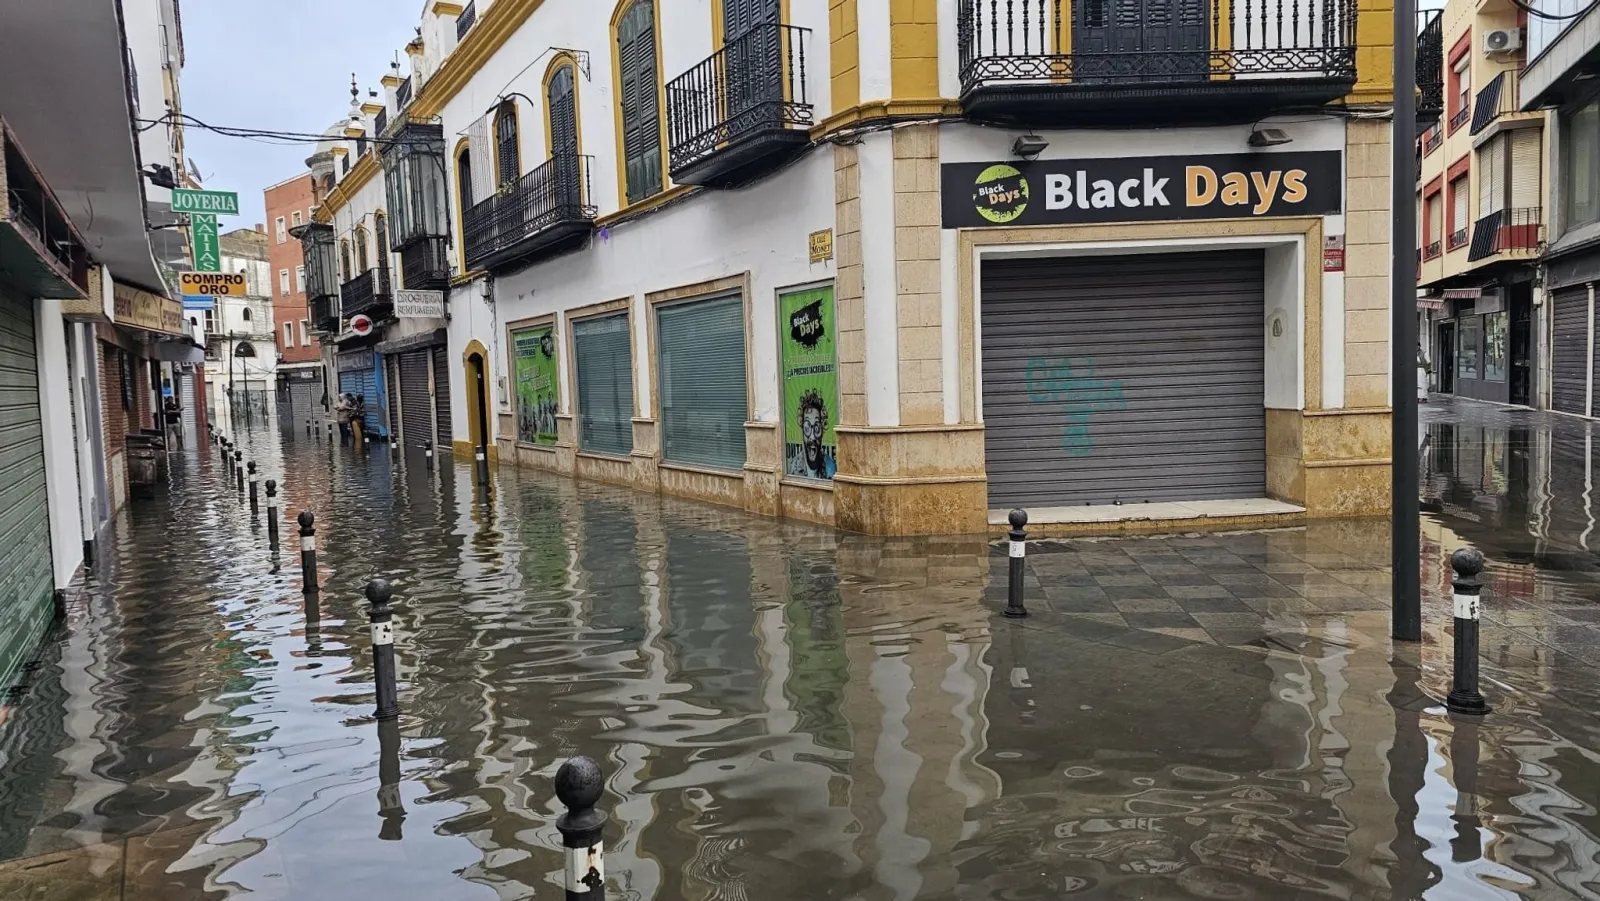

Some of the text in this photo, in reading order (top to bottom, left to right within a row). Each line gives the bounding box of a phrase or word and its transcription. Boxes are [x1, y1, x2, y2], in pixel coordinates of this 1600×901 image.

[978, 183, 1005, 197] Black
[988, 188, 1021, 206] Days
[1045, 165, 1307, 215] Black Days
[174, 192, 237, 211] JOYERIA
[195, 214, 217, 271] MATIAS
[181, 273, 244, 285] COMPRO
[199, 284, 229, 295] ORO
[793, 312, 810, 328] Black
[800, 318, 820, 337] Days
